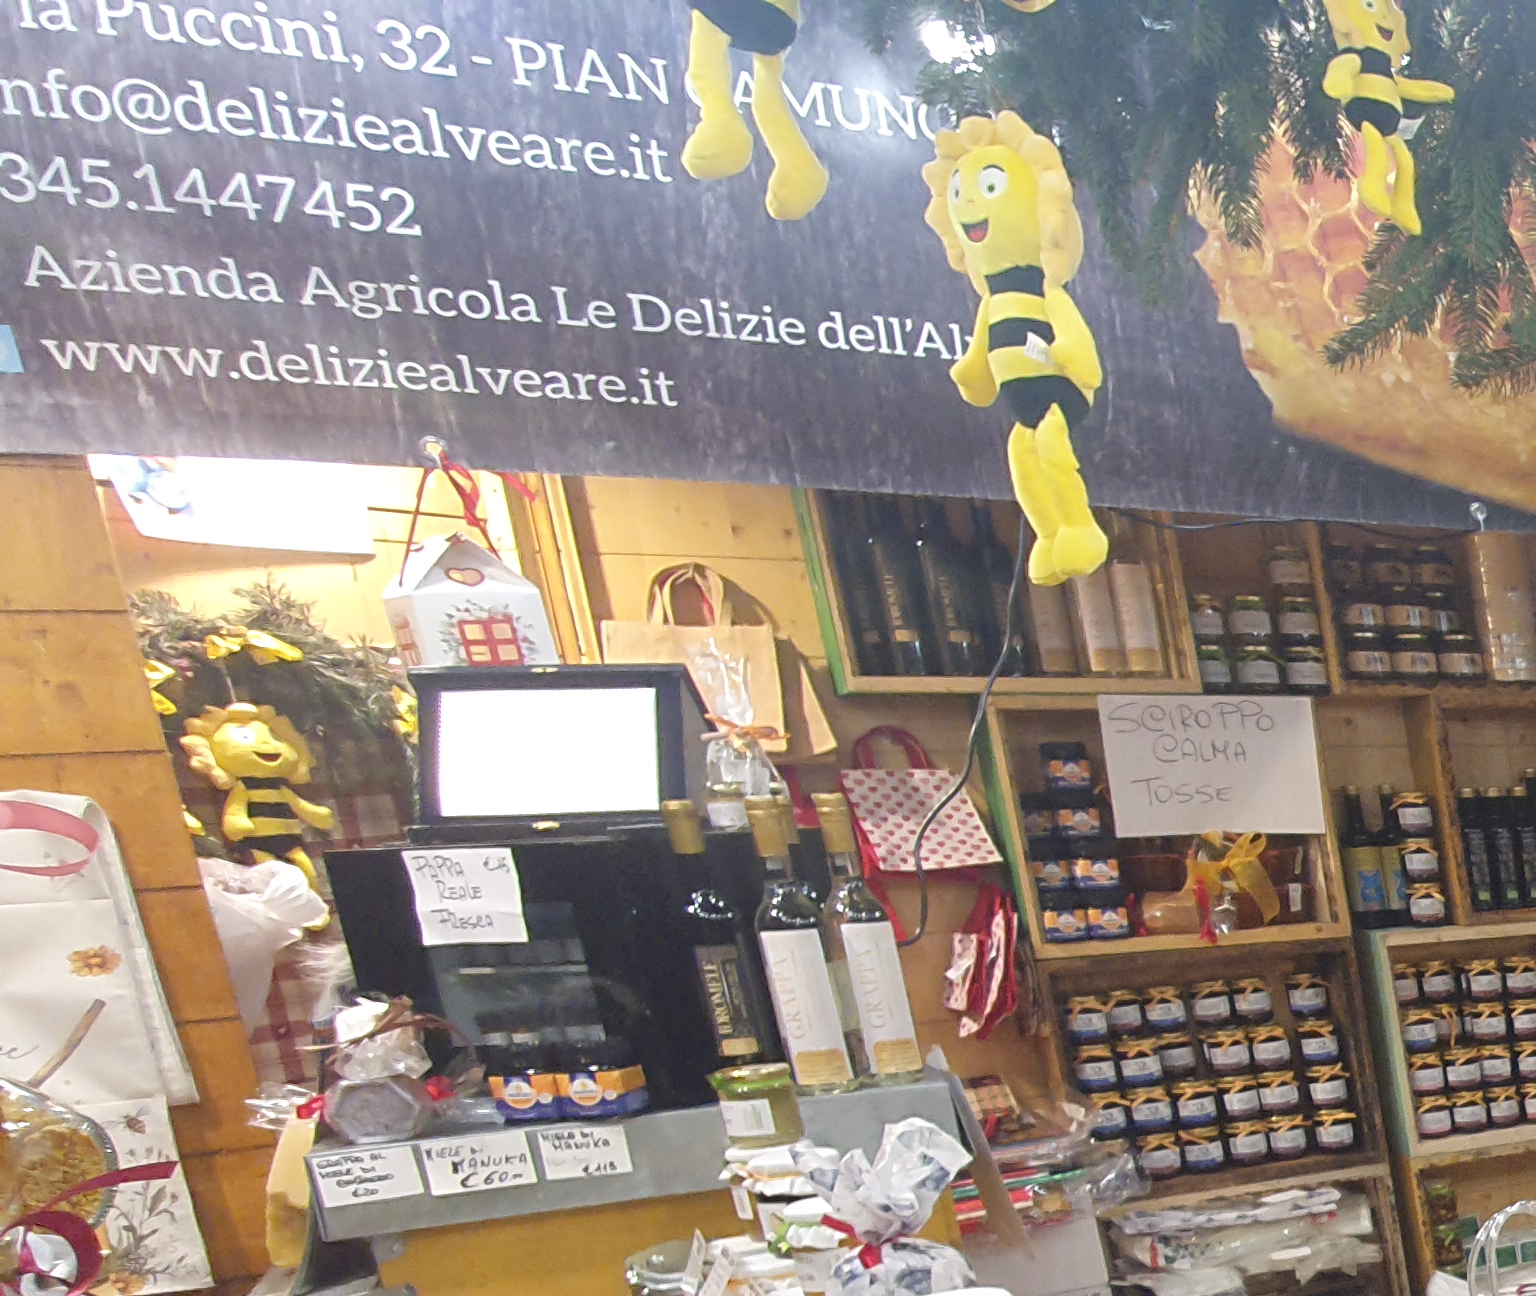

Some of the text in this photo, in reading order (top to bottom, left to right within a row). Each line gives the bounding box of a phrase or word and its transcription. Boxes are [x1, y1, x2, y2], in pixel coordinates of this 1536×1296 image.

[97, 0, 364, 72] Puccini,
[377, 19, 458, 77] 32
[505, 36, 670, 105] PIAN
[0, 68, 673, 183] nfo@deliziealveare.it
[0, 151, 423, 236] 345.1447452
[24, 245, 284, 304] Azienda
[301, 265, 543, 324] Agricola
[550, 286, 617, 330] Le
[627, 293, 816, 345] Delizie
[40, 337, 679, 409] www.deliziealveare.it
[1107, 701, 1274, 734] SCIROPPO
[1153, 735, 1249, 765] CALMA
[1131, 776, 1232, 805] TOSSE
[435, 880, 484, 903] REALE
[450, 1153, 528, 1174] MANUKA
